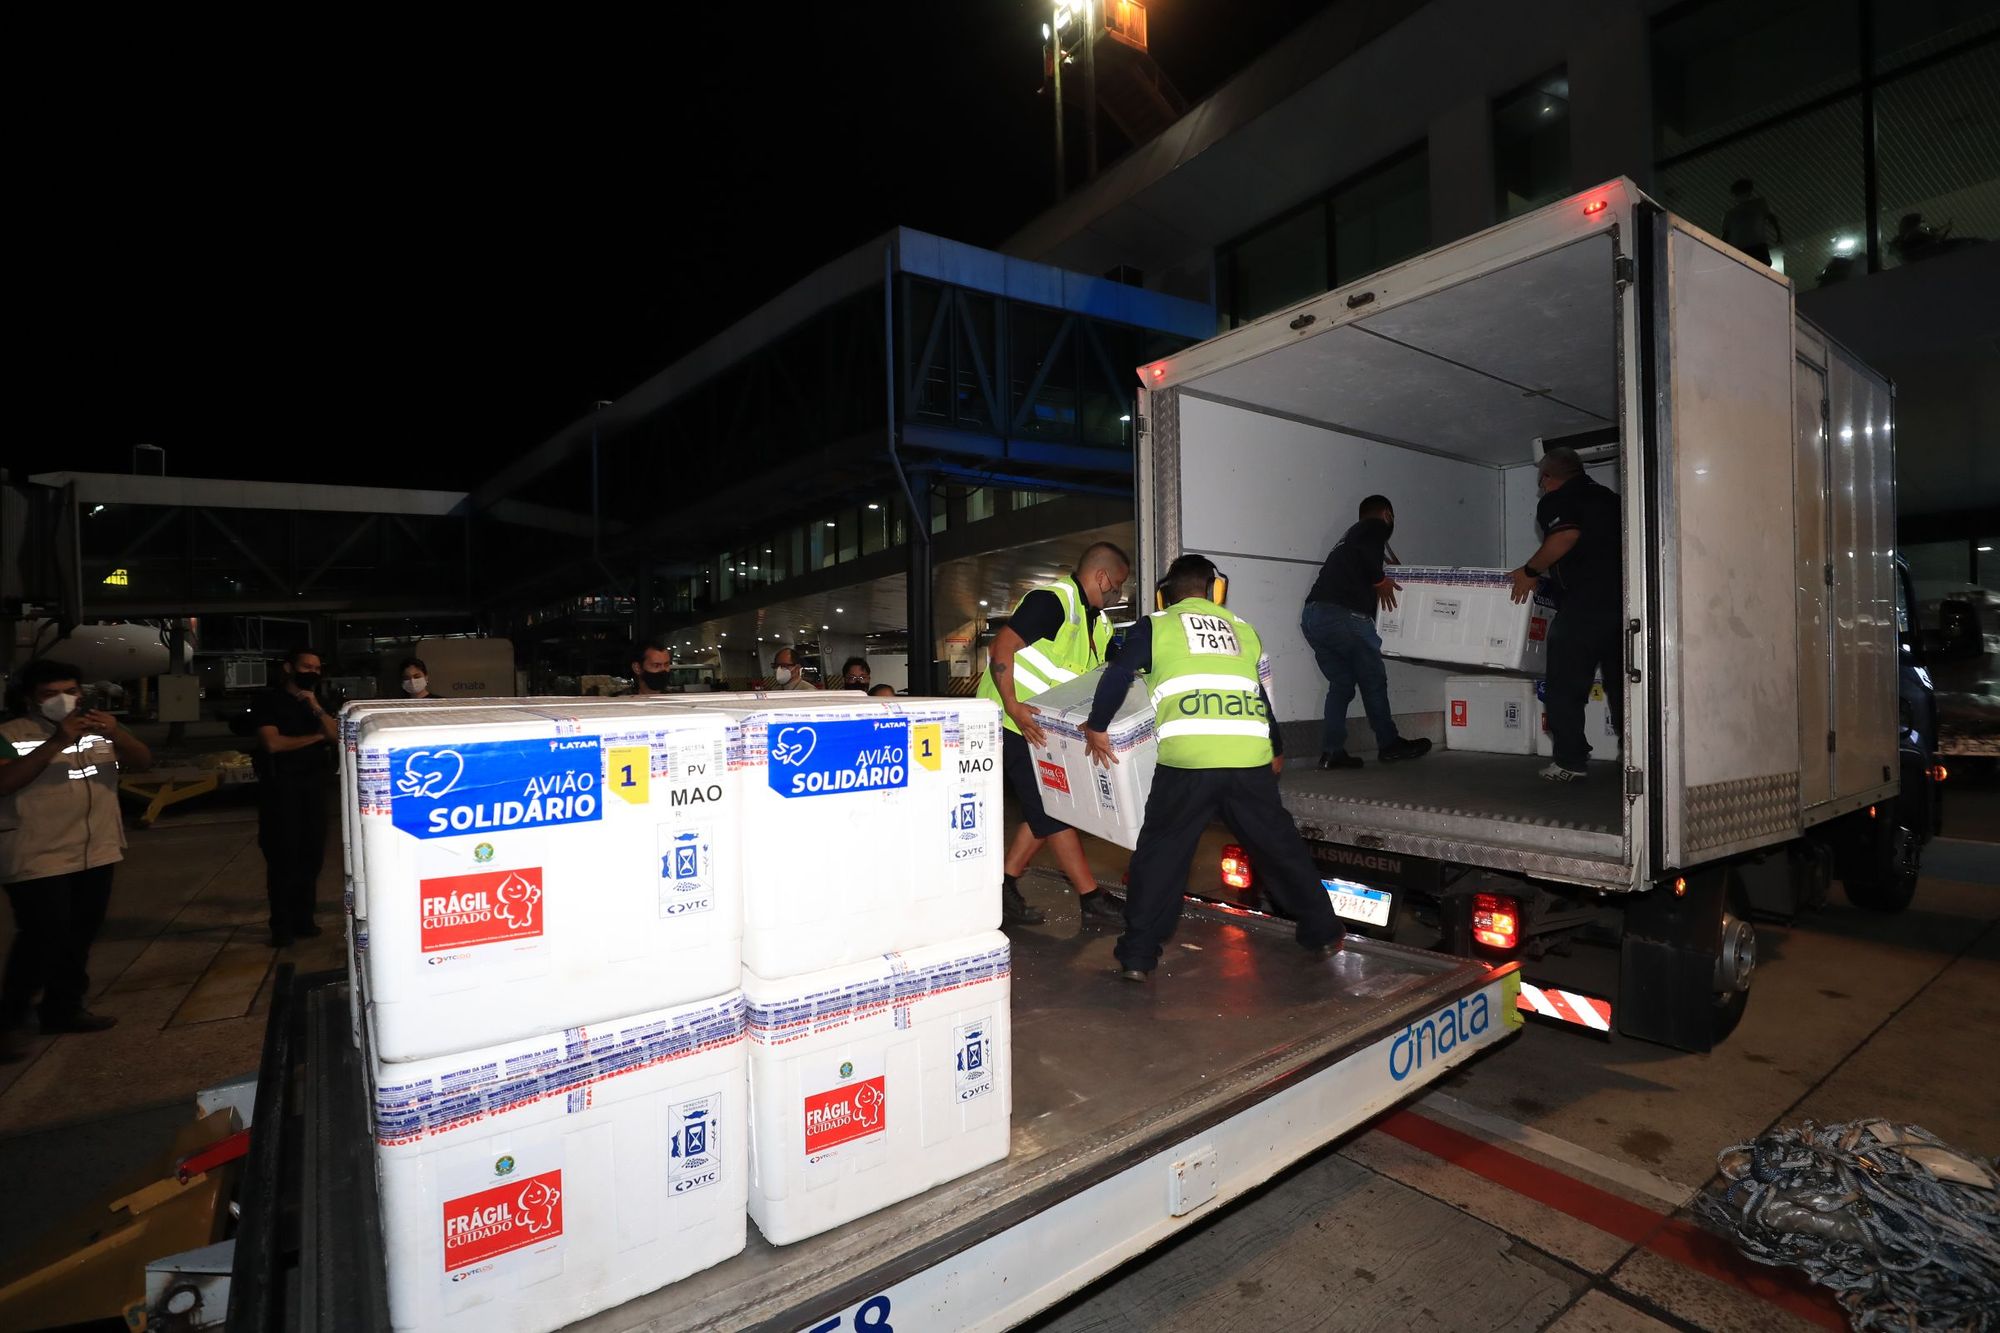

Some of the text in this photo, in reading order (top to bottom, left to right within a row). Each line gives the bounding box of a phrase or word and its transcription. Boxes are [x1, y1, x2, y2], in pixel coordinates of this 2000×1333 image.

[1189, 616, 1231, 634] DNA
[1196, 633, 1239, 652] 7811
[880, 721, 907, 729] LATAM
[559, 740, 598, 750] LATAM
[855, 745, 903, 766] AVIÃO
[921, 738, 933, 757] 1
[970, 740, 984, 750] PV
[620, 765, 637, 787] 1
[688, 763, 706, 776] PV
[958, 757, 994, 774] MAO
[523, 770, 594, 798] AVIÃO
[791, 761, 904, 794] SOLIDÁRIO
[671, 785, 723, 807] MAO
[428, 791, 596, 833] SOLIDÁRIO
[1312, 848, 1402, 873] LKSWAGEN
[423, 890, 491, 917] FRÁGIL
[423, 911, 491, 929] CUIDADO
[1389, 992, 1489, 1081] dnata
[806, 1102, 851, 1126] FRÁGIL
[806, 1115, 851, 1137] CUIDADO
[447, 1202, 512, 1237] FRÁGIL
[447, 1221, 512, 1249] CUIDADO
